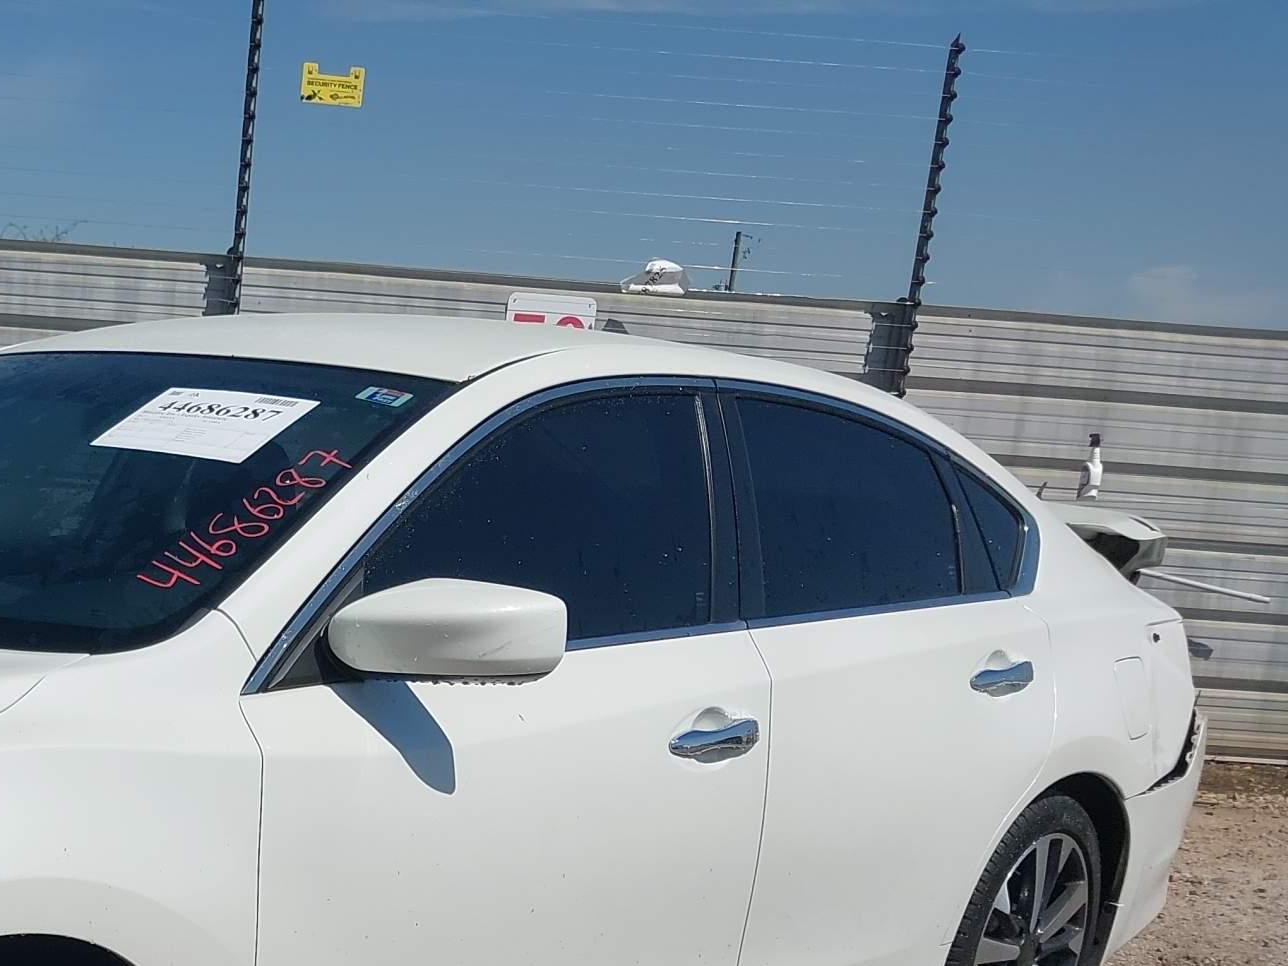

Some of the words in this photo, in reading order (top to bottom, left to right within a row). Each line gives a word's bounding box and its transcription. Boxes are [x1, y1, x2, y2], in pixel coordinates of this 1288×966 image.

[307, 80, 337, 89] SECURITY
[158, 400, 283, 422] 44686287
[136, 449, 353, 588] 44686287
